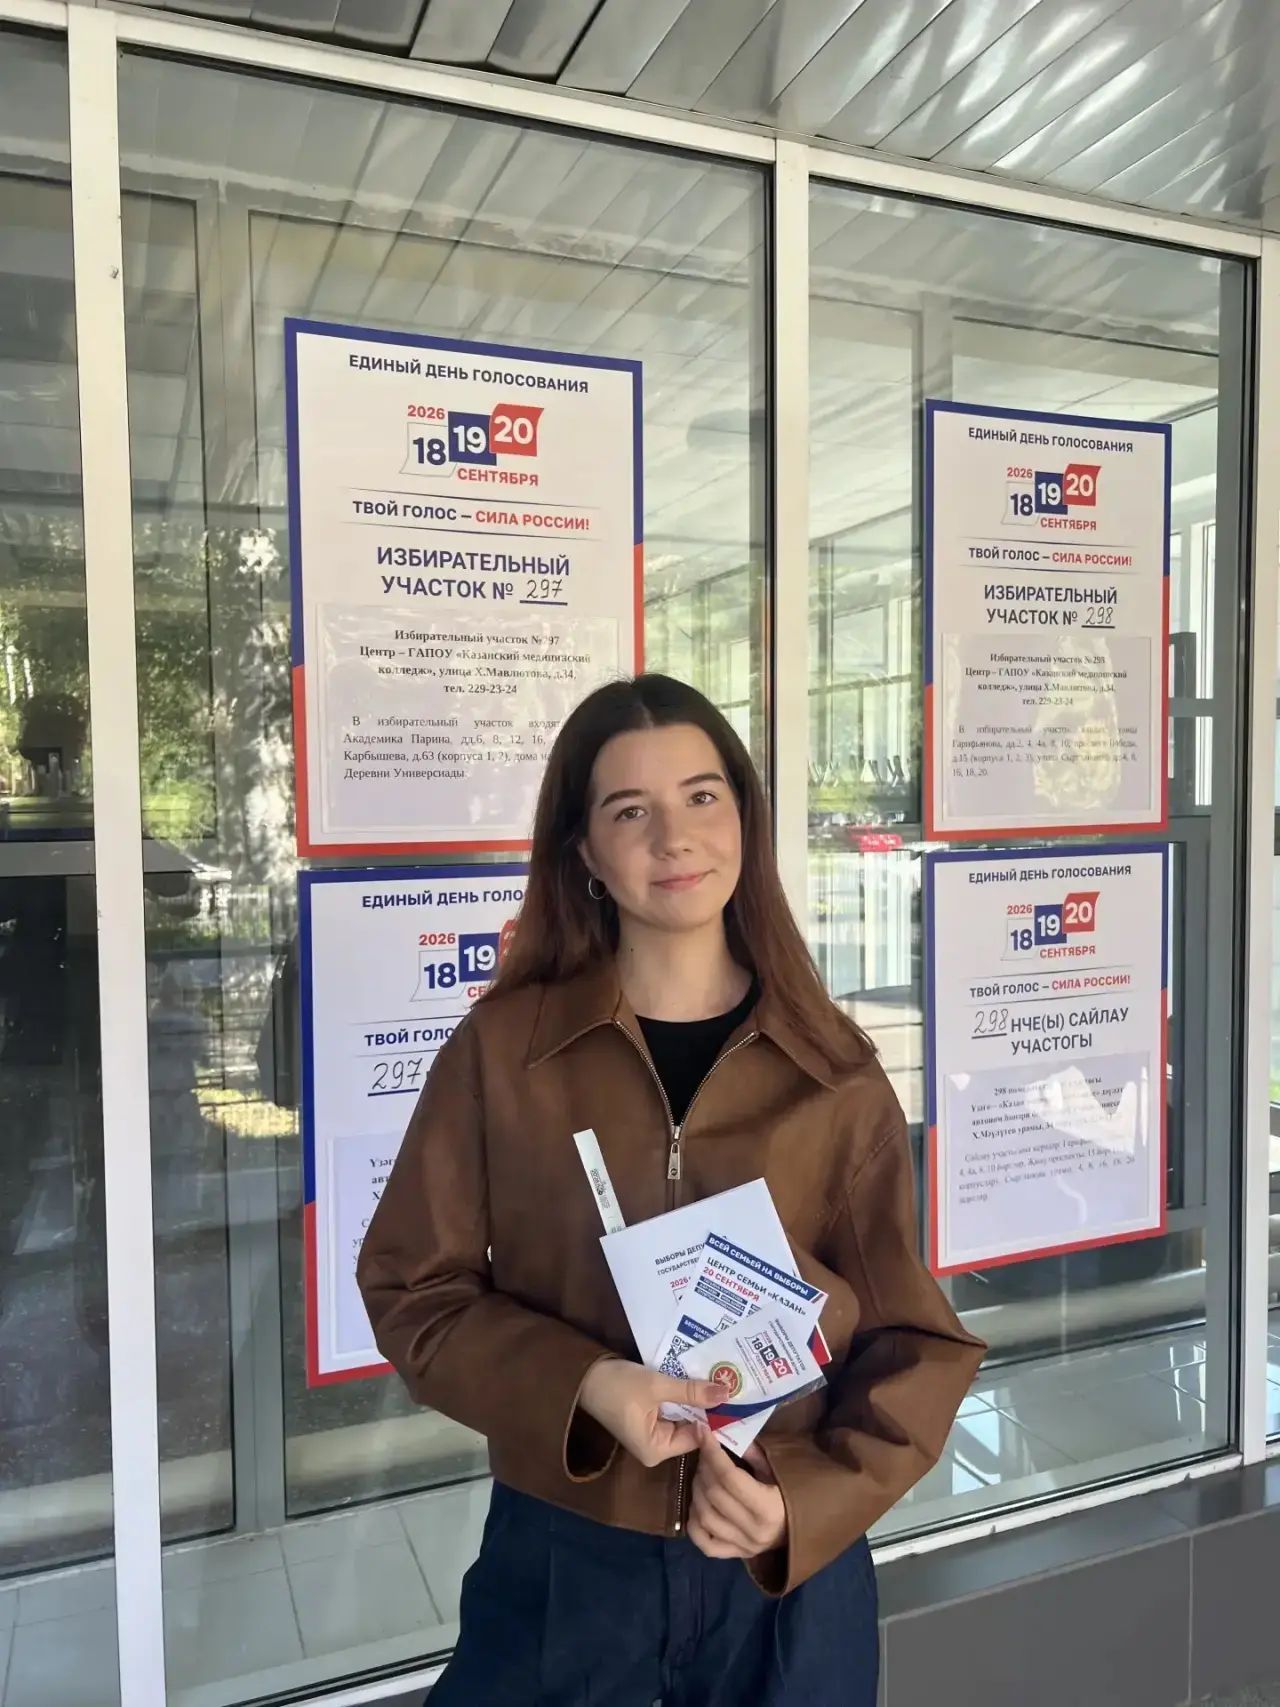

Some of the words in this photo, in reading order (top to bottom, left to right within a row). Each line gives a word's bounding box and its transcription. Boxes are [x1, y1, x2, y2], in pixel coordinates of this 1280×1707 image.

[349, 355, 421, 375] ЕДИНЫЙ
[425, 364, 468, 381] ДЕНЬ
[473, 370, 589, 393] ГОЛОСОВАНИЯ
[408, 405, 445, 420] 2026
[413, 437, 446, 465] 18
[453, 425, 486, 453] 19
[494, 415, 533, 444] 20
[969, 427, 1016, 442] ЕДИНЫЙ
[1020, 434, 1049, 445] ДЕНЬ
[1052, 437, 1133, 452] ГОЛОСОВАНИЯ
[458, 468, 538, 486] СЕНТЯБРЯ
[1007, 467, 1032, 478] 2026
[1010, 494, 1033, 516] 18
[1038, 482, 1061, 505] 19
[1066, 474, 1093, 496] 20
[353, 500, 398, 516] ТВОЙ
[403, 504, 456, 520] ГОЛОС
[475, 511, 518, 526] СИЛА
[523, 514, 589, 530] РОССИИ!
[1041, 517, 1096, 531] СЕНТЯБРЯ
[377, 547, 569, 576] ИЗБИРАТЕЛЬНЫЙ
[969, 547, 999, 559] ТВОЙ
[1002, 549, 1039, 561] ГОЛОС
[1052, 552, 1081, 564] СИЛА
[1085, 554, 1132, 566] РОССИИ!
[382, 576, 485, 599] УЧАСТОК
[493, 582, 513, 599] №
[526, 579, 563, 599] 297
[985, 585, 1117, 604] ИЗБИРАТЕЛЬНЫЙ
[987, 609, 1059, 625] УЧАСТОК
[1063, 611, 1077, 625] №
[1086, 607, 1113, 625] 298
[395, 630, 483, 645] Избирательный
[486, 635, 528, 646] участок
[360, 646, 395, 658] Центр
[408, 648, 452, 659] ГАПОУ
[456, 649, 520, 662] «Казанский
[379, 665, 435, 677] колледж»,
[439, 667, 472, 678] улица
[966, 668, 990, 678] Центр
[999, 668, 1029, 676] ГАПОУ
[444, 684, 464, 694] тел.
[468, 684, 517, 694] 229-23-24
[353, 716, 360, 726] В
[378, 716, 457, 728] избирательный
[474, 719, 512, 730] участок
[344, 734, 402, 745] Академика
[493, 734, 502, 744] 8,
[510, 735, 524, 744] 12,
[532, 735, 546, 745] 16,
[344, 751, 409, 762] Карбышева,
[412, 751, 434, 762] д.63
[438, 752, 482, 764] (корпуса
[514, 753, 537, 763] дома
[344, 769, 390, 780] Деревни
[969, 869, 1016, 883] ЕДИНЫЙ
[1020, 870, 1048, 881] ДЕНЬ
[1051, 865, 1131, 879] ГОЛОСОВАНИЯ
[362, 891, 432, 909] ЕДИНЫЙ
[437, 892, 478, 906] ДЕНЬ
[1007, 904, 1032, 915] 2026
[1010, 929, 1032, 951] 18
[1038, 914, 1060, 936] 19
[1065, 902, 1092, 924] 20
[419, 933, 456, 946] 2026
[1040, 945, 1095, 959] СЕНТЯБРЯ
[424, 963, 456, 989] 18
[464, 945, 496, 971] 19
[970, 983, 1000, 998] ТВОЙ
[1003, 982, 1038, 994] ГОЛОС
[1052, 978, 1081, 991] СИЛА
[1084, 975, 1130, 988] РОССИИ!
[975, 1009, 1008, 1033] 298
[1012, 1014, 1064, 1032] НЧЕ(Ы)
[1069, 1008, 1129, 1027] САЙЛАУ
[365, 1029, 408, 1046] ТВОЙ
[414, 1028, 455, 1042] ГОЛО
[1011, 1033, 1092, 1055] УЧАСТОГЫ
[372, 1058, 423, 1090] 297
[655, 1250, 686, 1265] ВЫБОРЫ
[708, 1236, 729, 1254] ВСЕЙ
[730, 1249, 762, 1270] СЕМЬЕЙ
[762, 1266, 772, 1277] НА
[774, 1271, 809, 1295] ВЫБОРЫ
[703, 1266, 714, 1276] 20
[715, 1272, 760, 1302] СЕНТЯБРЯ
[707, 1257, 736, 1275] ЦЕНТР
[737, 1273, 767, 1293] СЕМЬИ
[768, 1291, 806, 1316] «КАЗАН»
[752, 1337, 763, 1350] 18
[764, 1348, 774, 1359] 19
[774, 1360, 787, 1375] 20
